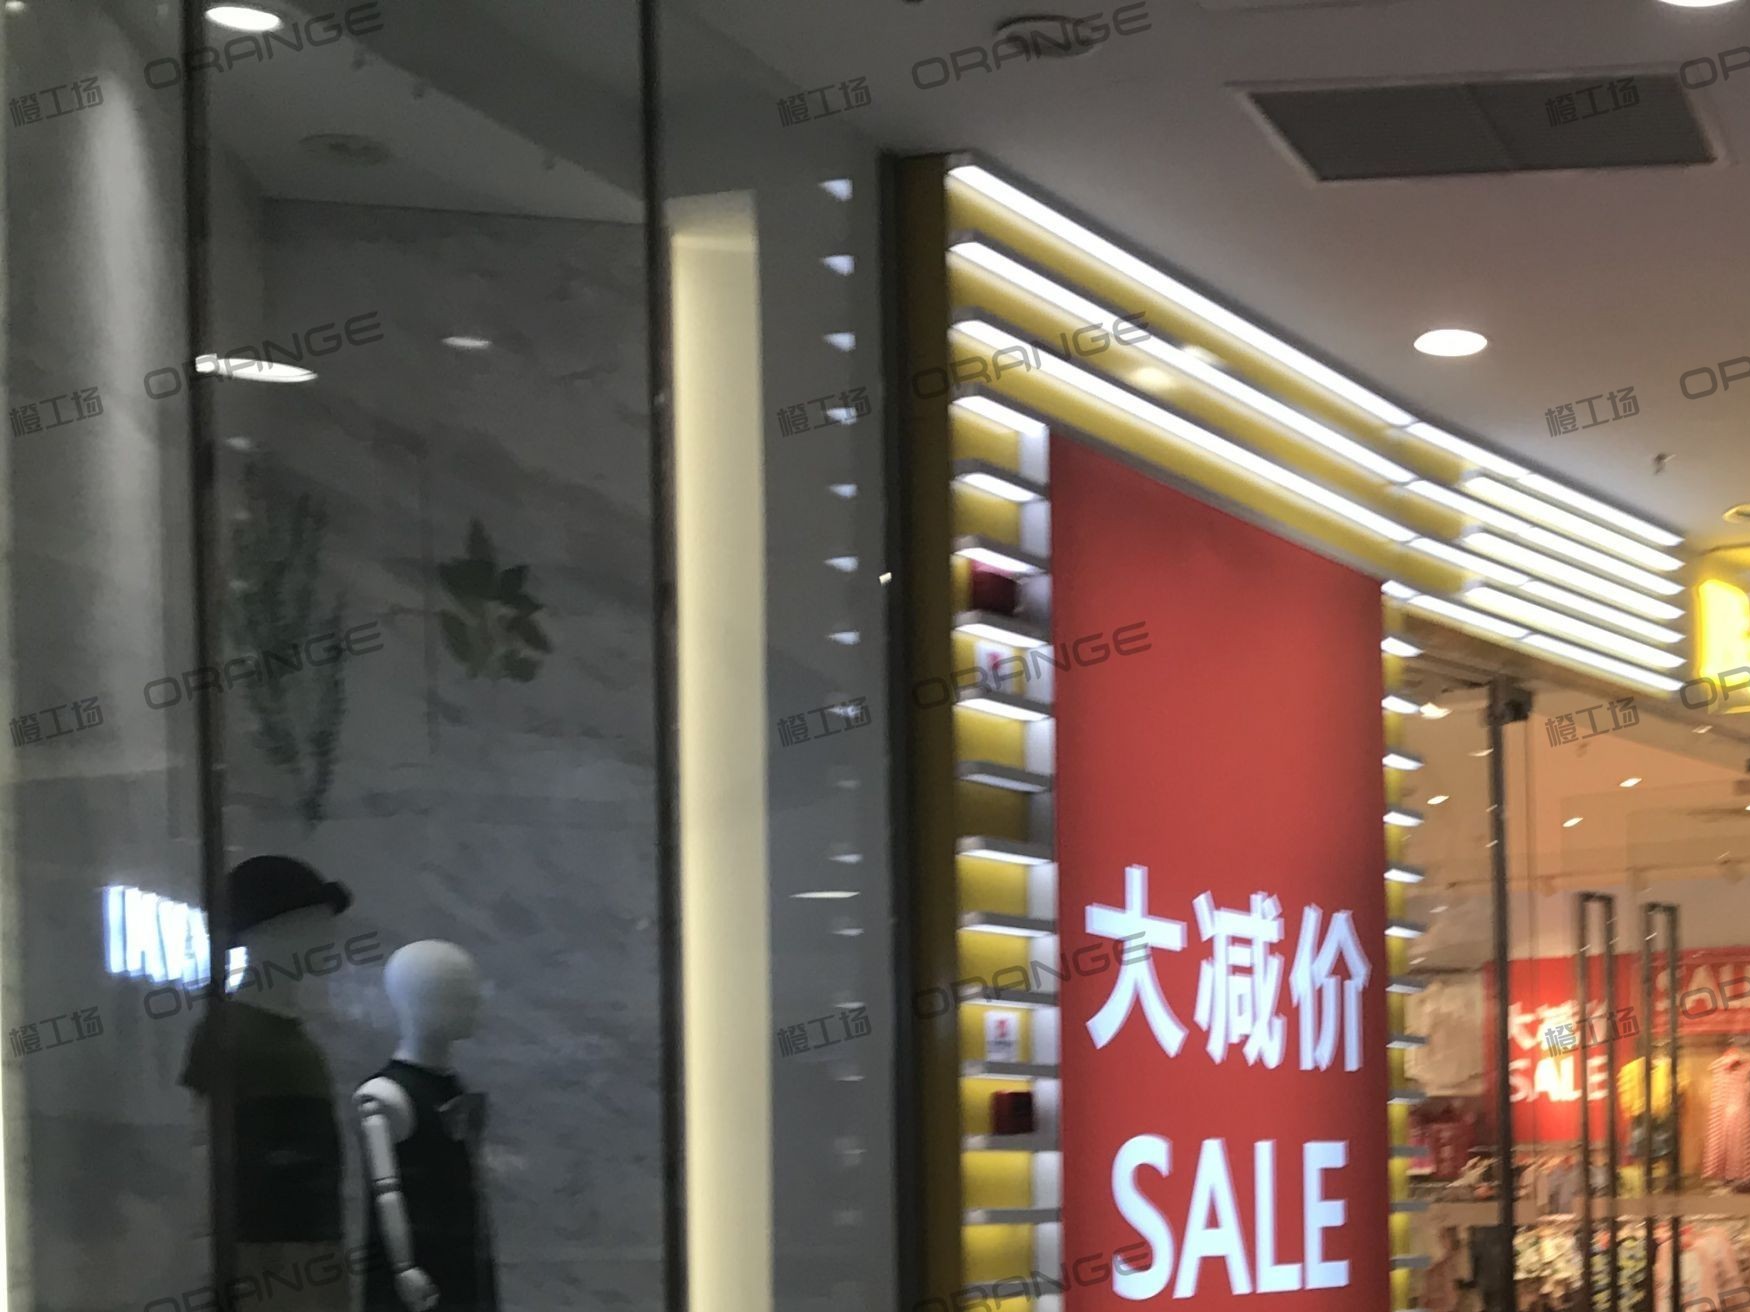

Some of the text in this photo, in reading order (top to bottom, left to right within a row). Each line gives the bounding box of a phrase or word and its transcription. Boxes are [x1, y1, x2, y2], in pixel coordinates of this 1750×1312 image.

[1084, 864, 1372, 1072] 大减价
[1508, 1055, 1609, 1102] SALE
[1111, 1133, 1350, 1300] SALE
